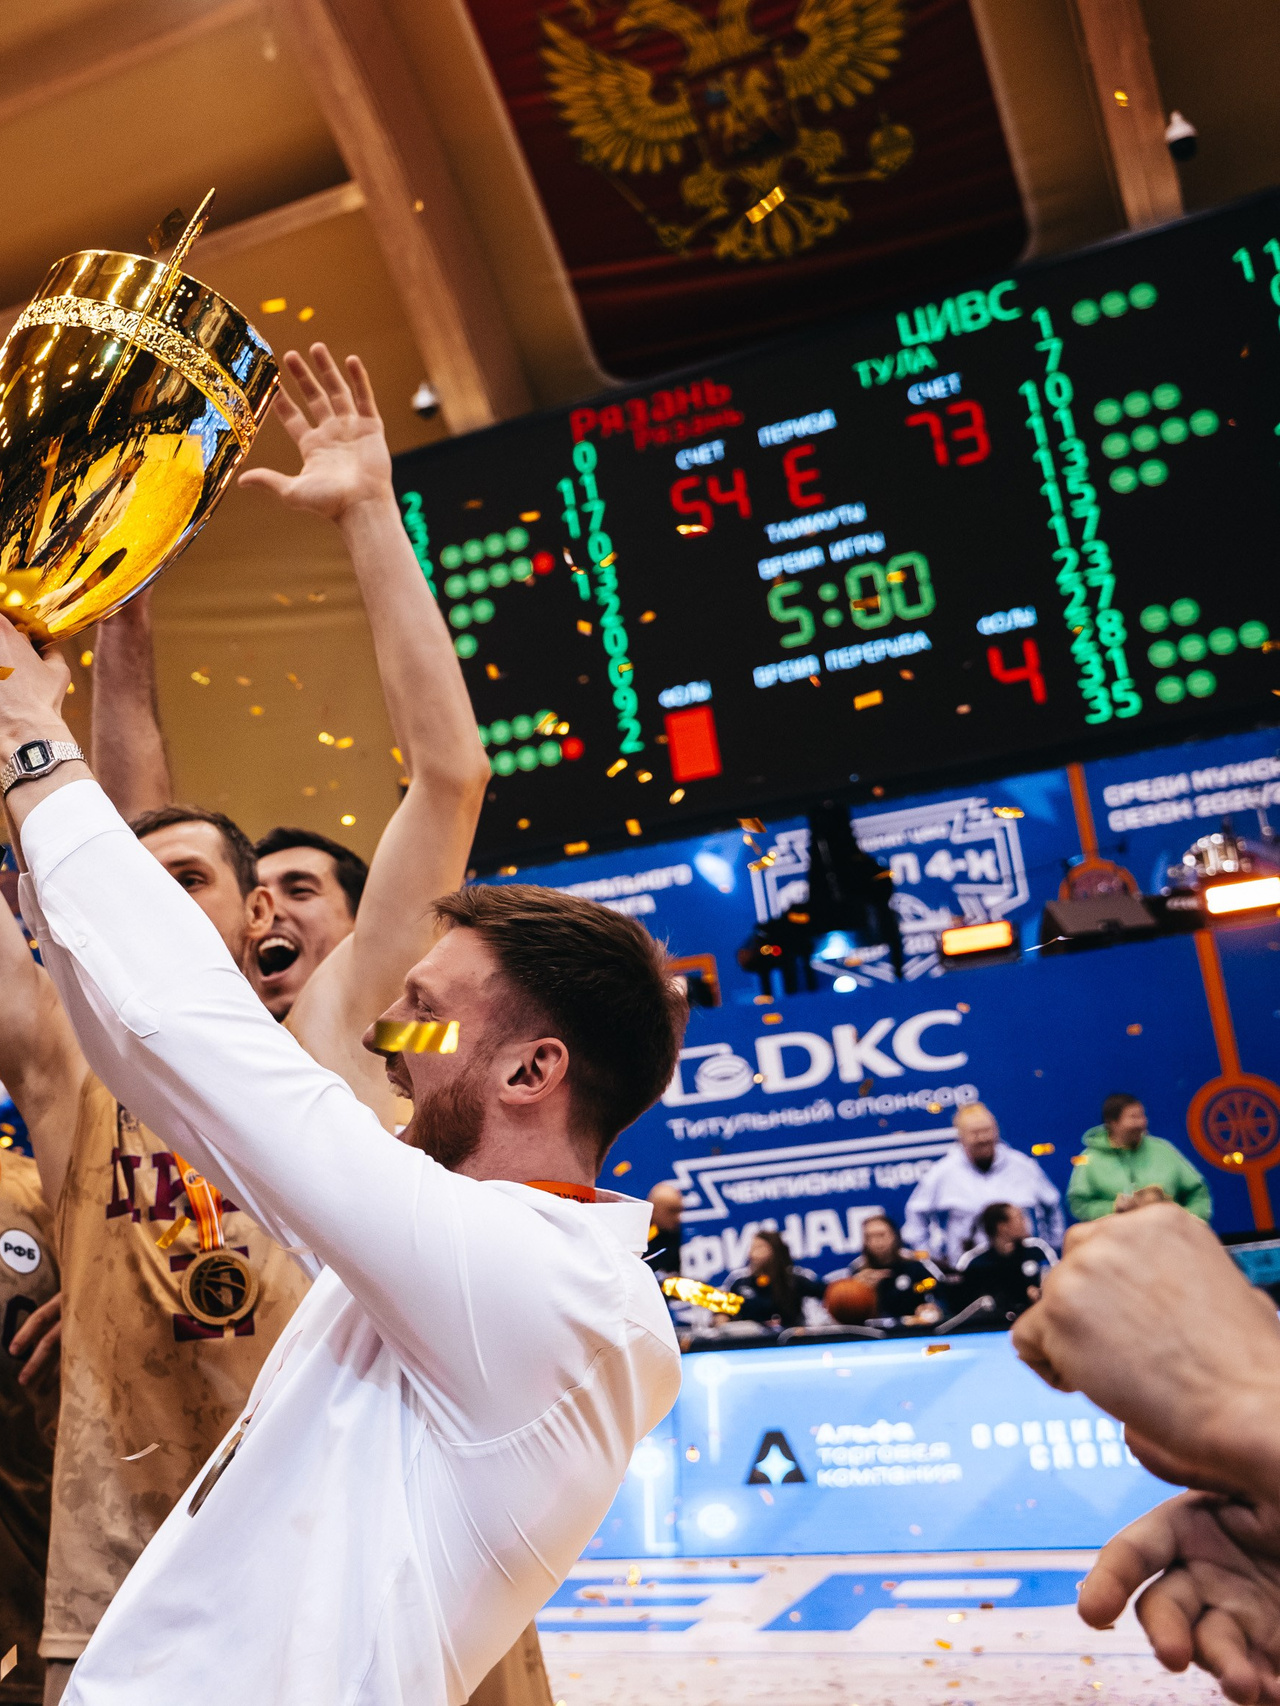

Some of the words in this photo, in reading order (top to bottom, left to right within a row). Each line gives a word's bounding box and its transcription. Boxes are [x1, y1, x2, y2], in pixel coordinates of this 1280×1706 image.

[896, 279, 1022, 347] ЦИВС
[852, 344, 938, 389] ТУЛА
[904, 399, 991, 467] 73
[670, 468, 752, 539] 54
[767, 551, 936, 649] 5:00
[987, 637, 1048, 704] 4
[754, 1008, 968, 1094] DKC
[666, 1098, 834, 1141] Титульный
[3, 1241, 36, 1261] РФБ
